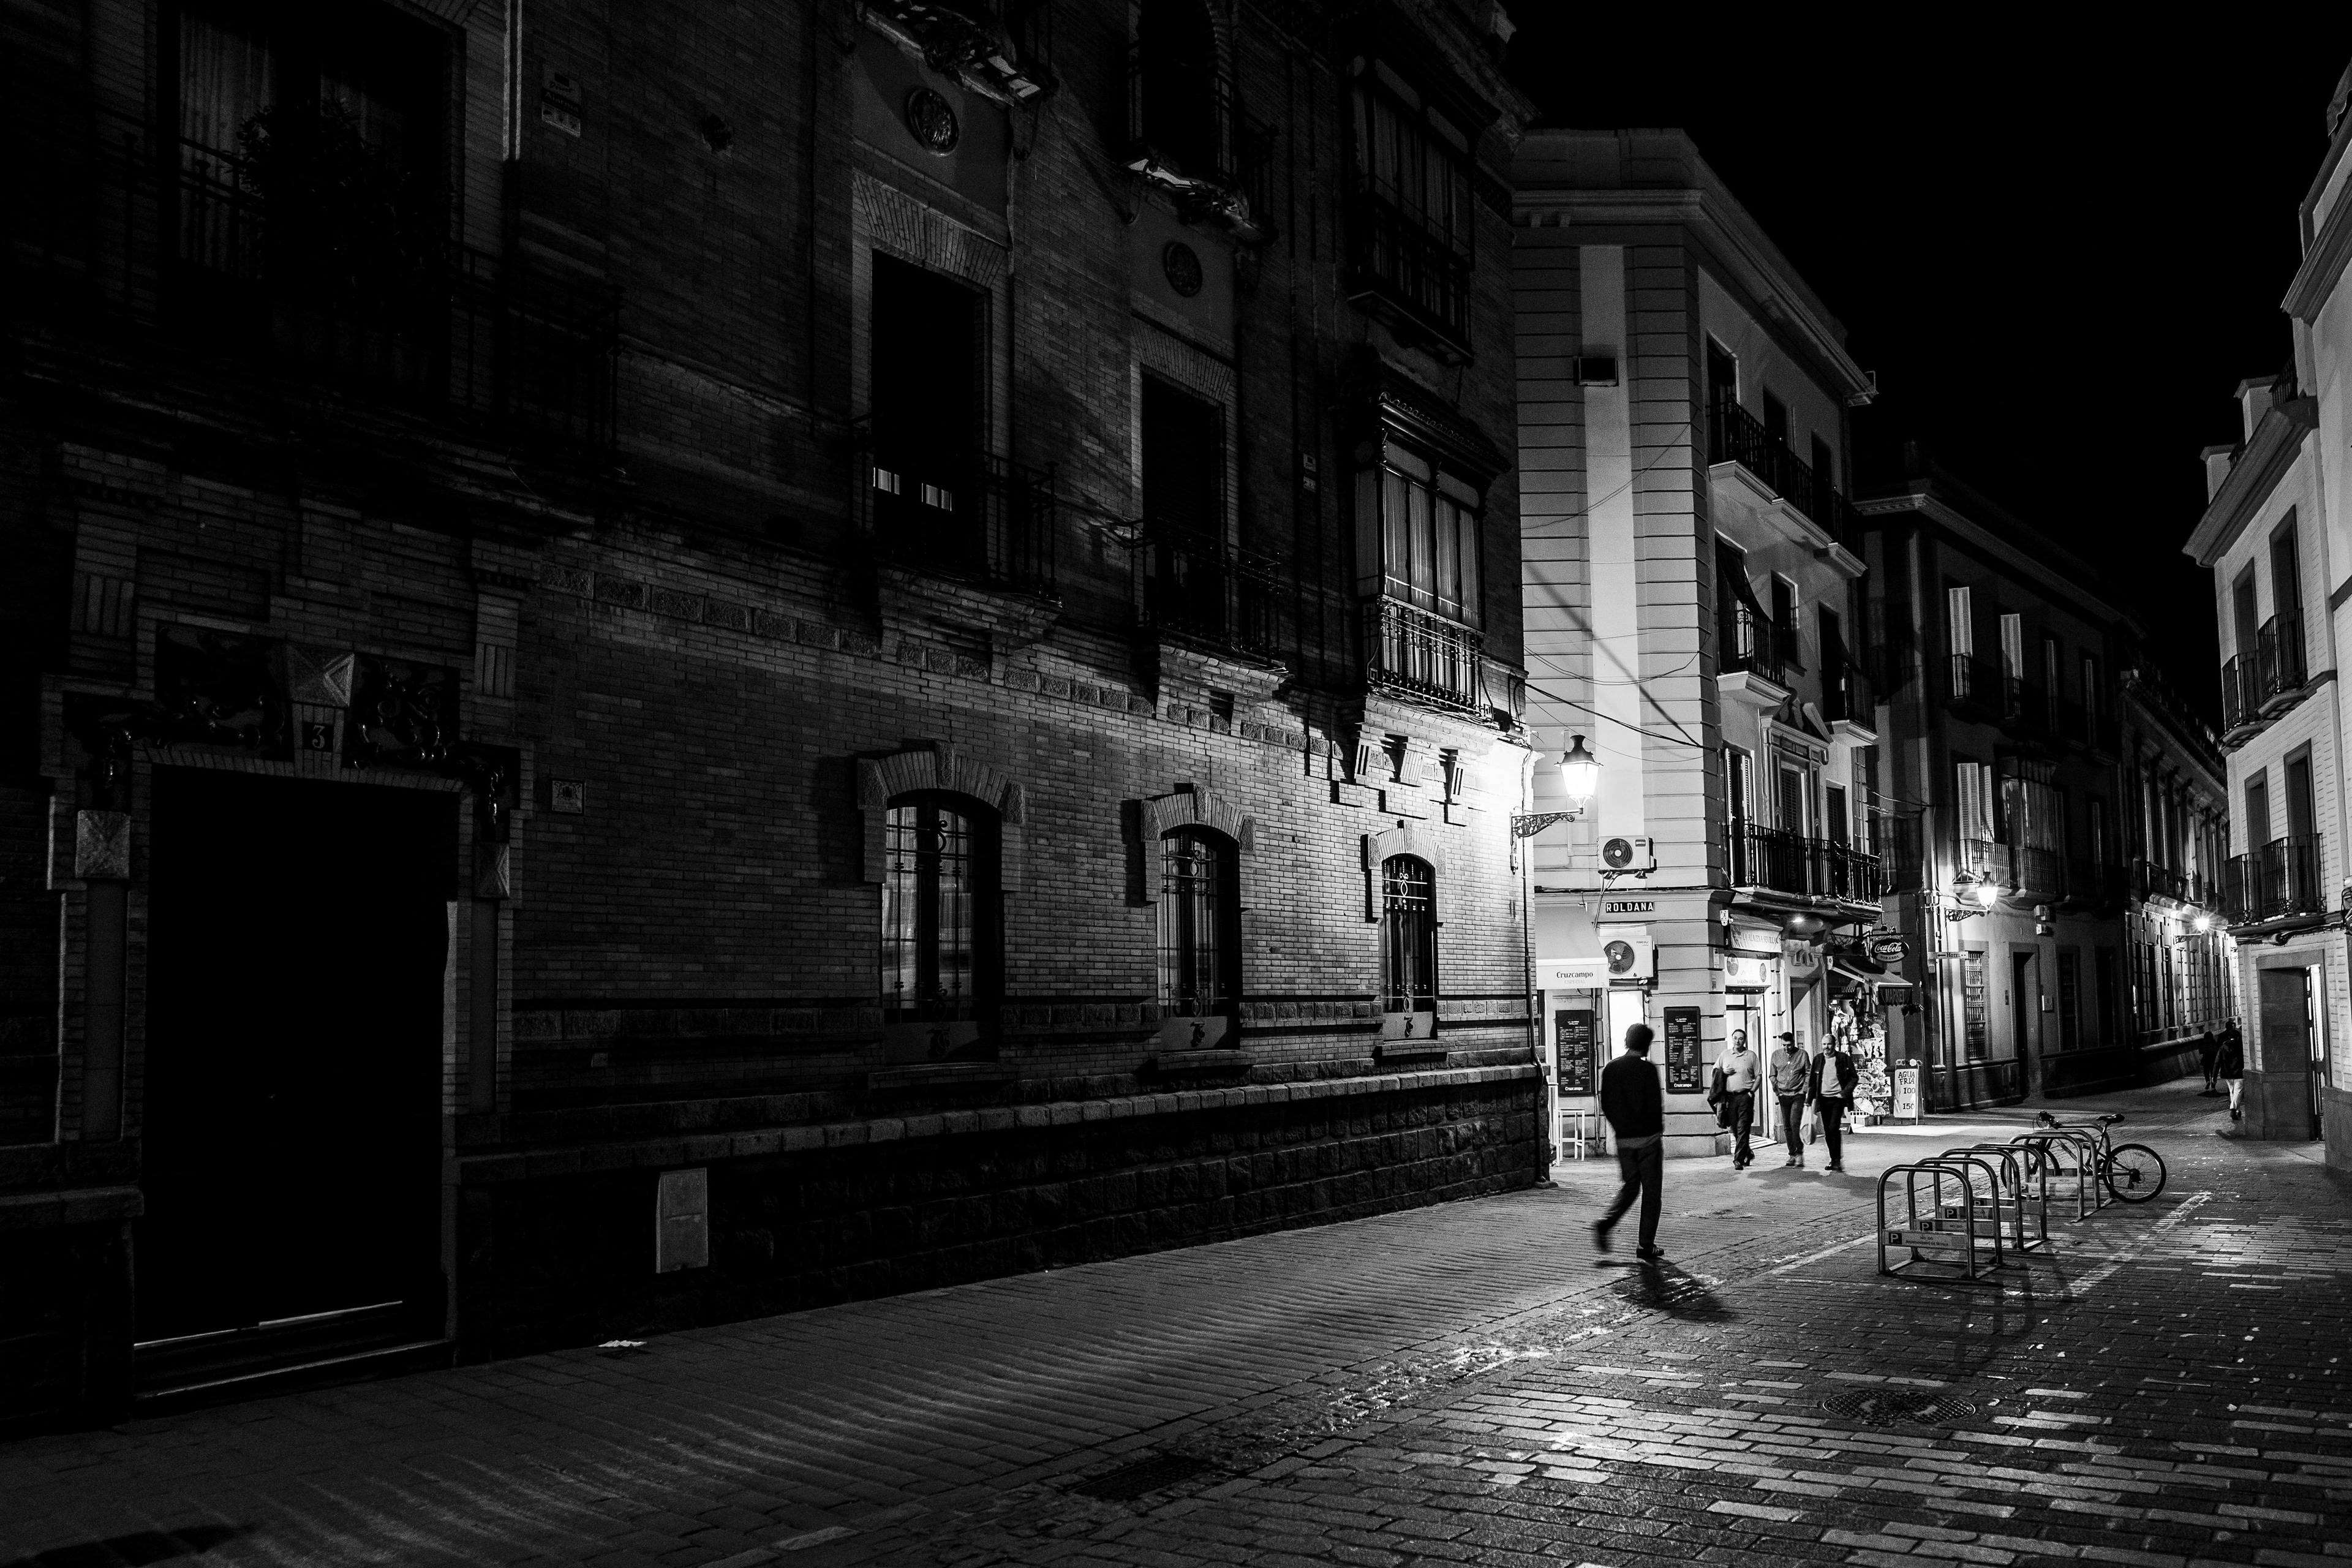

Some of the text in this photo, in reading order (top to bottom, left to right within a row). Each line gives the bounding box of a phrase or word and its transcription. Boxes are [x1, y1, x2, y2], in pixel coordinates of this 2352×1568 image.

[311, 725, 326, 749] 3
[1606, 902, 1654, 912] ROLDANA
[1874, 942, 1902, 953] Coca-Cola
[1947, 1209, 1954, 1218] P
[1922, 1223, 1929, 1231] P
[1891, 1233, 1899, 1243] P
